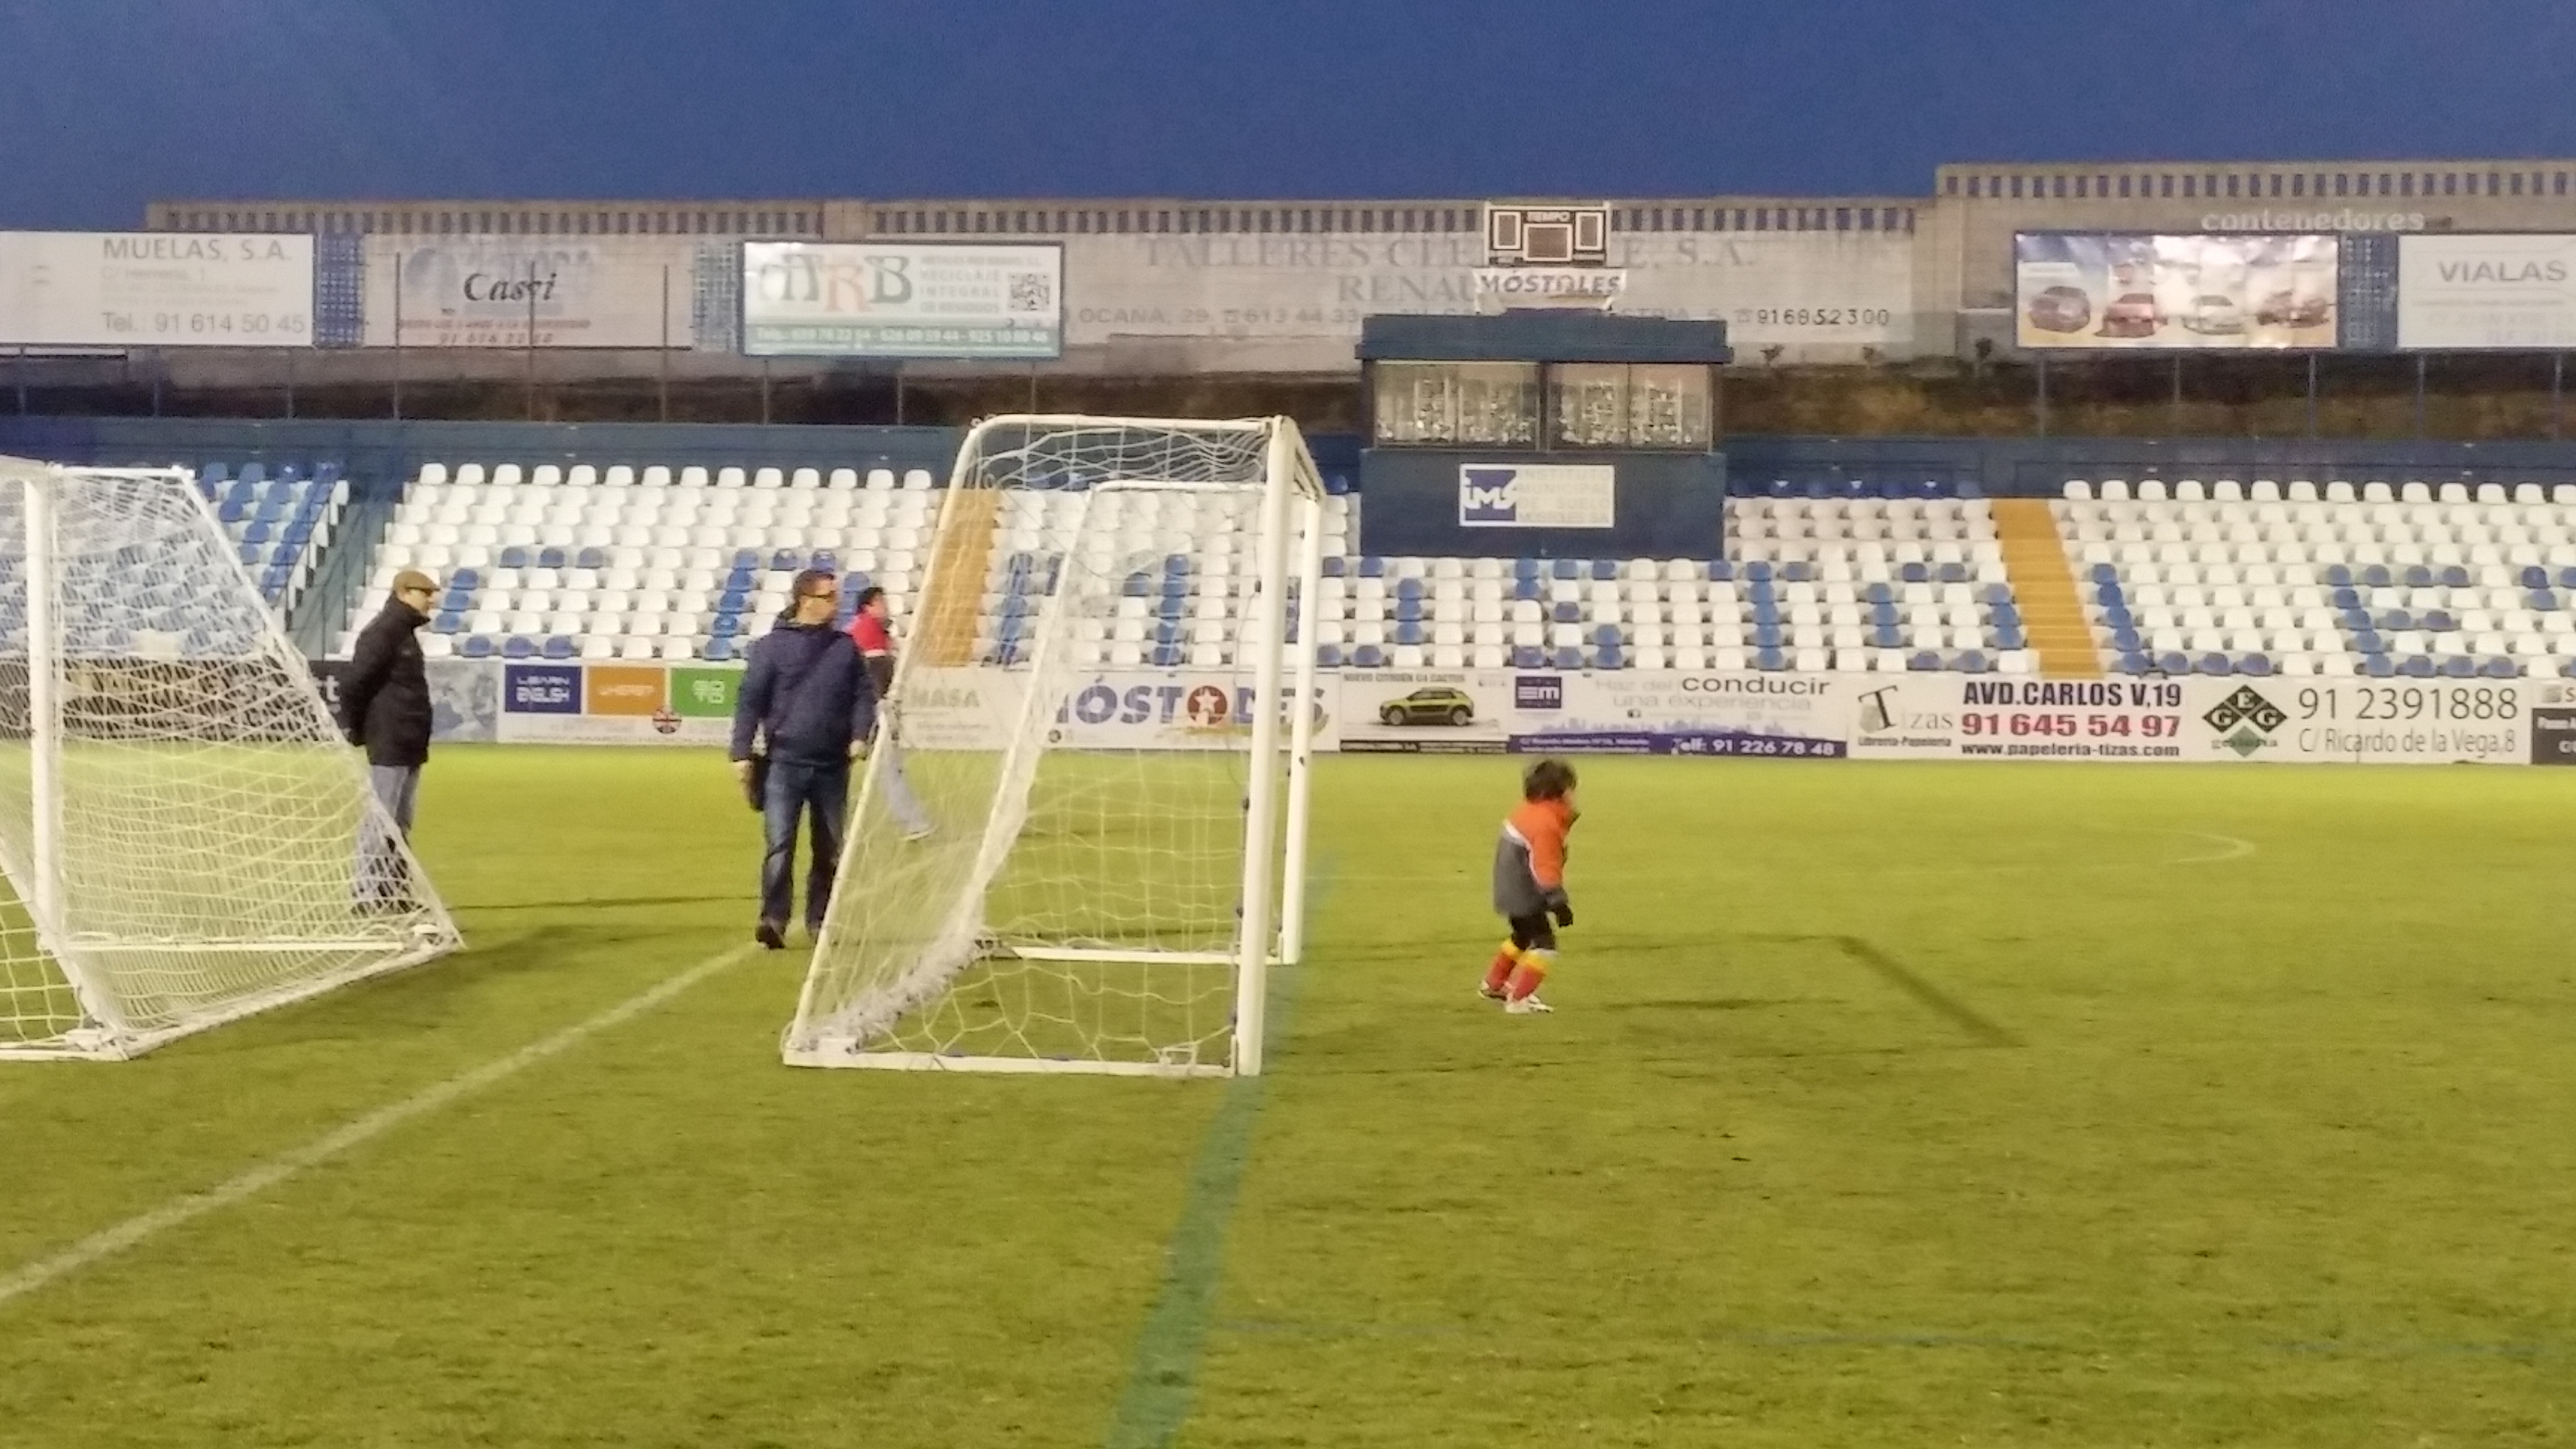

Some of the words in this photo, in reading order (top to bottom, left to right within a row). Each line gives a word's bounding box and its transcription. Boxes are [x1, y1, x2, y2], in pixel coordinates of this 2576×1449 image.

[2201, 208, 2426, 230] contenedores
[155, 313, 180, 333] 91
[191, 313, 233, 333] 614
[241, 313, 270, 334] 50
[277, 313, 305, 334] 45
[1682, 676, 1831, 695] conducir
[1962, 681, 2123, 707] AVD.CARLOS
[2298, 687, 2337, 720] 91
[2356, 687, 2518, 720] 2391888
[1961, 713, 1999, 736] 91
[2009, 714, 2076, 736] 645
[2087, 715, 2131, 737] 54
[2141, 715, 2180, 738] 97
[1713, 740, 1733, 754] 91
[1741, 741, 1777, 755] 226
[1782, 741, 1805, 755] 78
[1810, 742, 1835, 756] 48
[2299, 728, 2324, 752] C/
[2325, 728, 2396, 752] Ricardo
[2403, 728, 2426, 752] de
[2433, 727, 2447, 753] la
